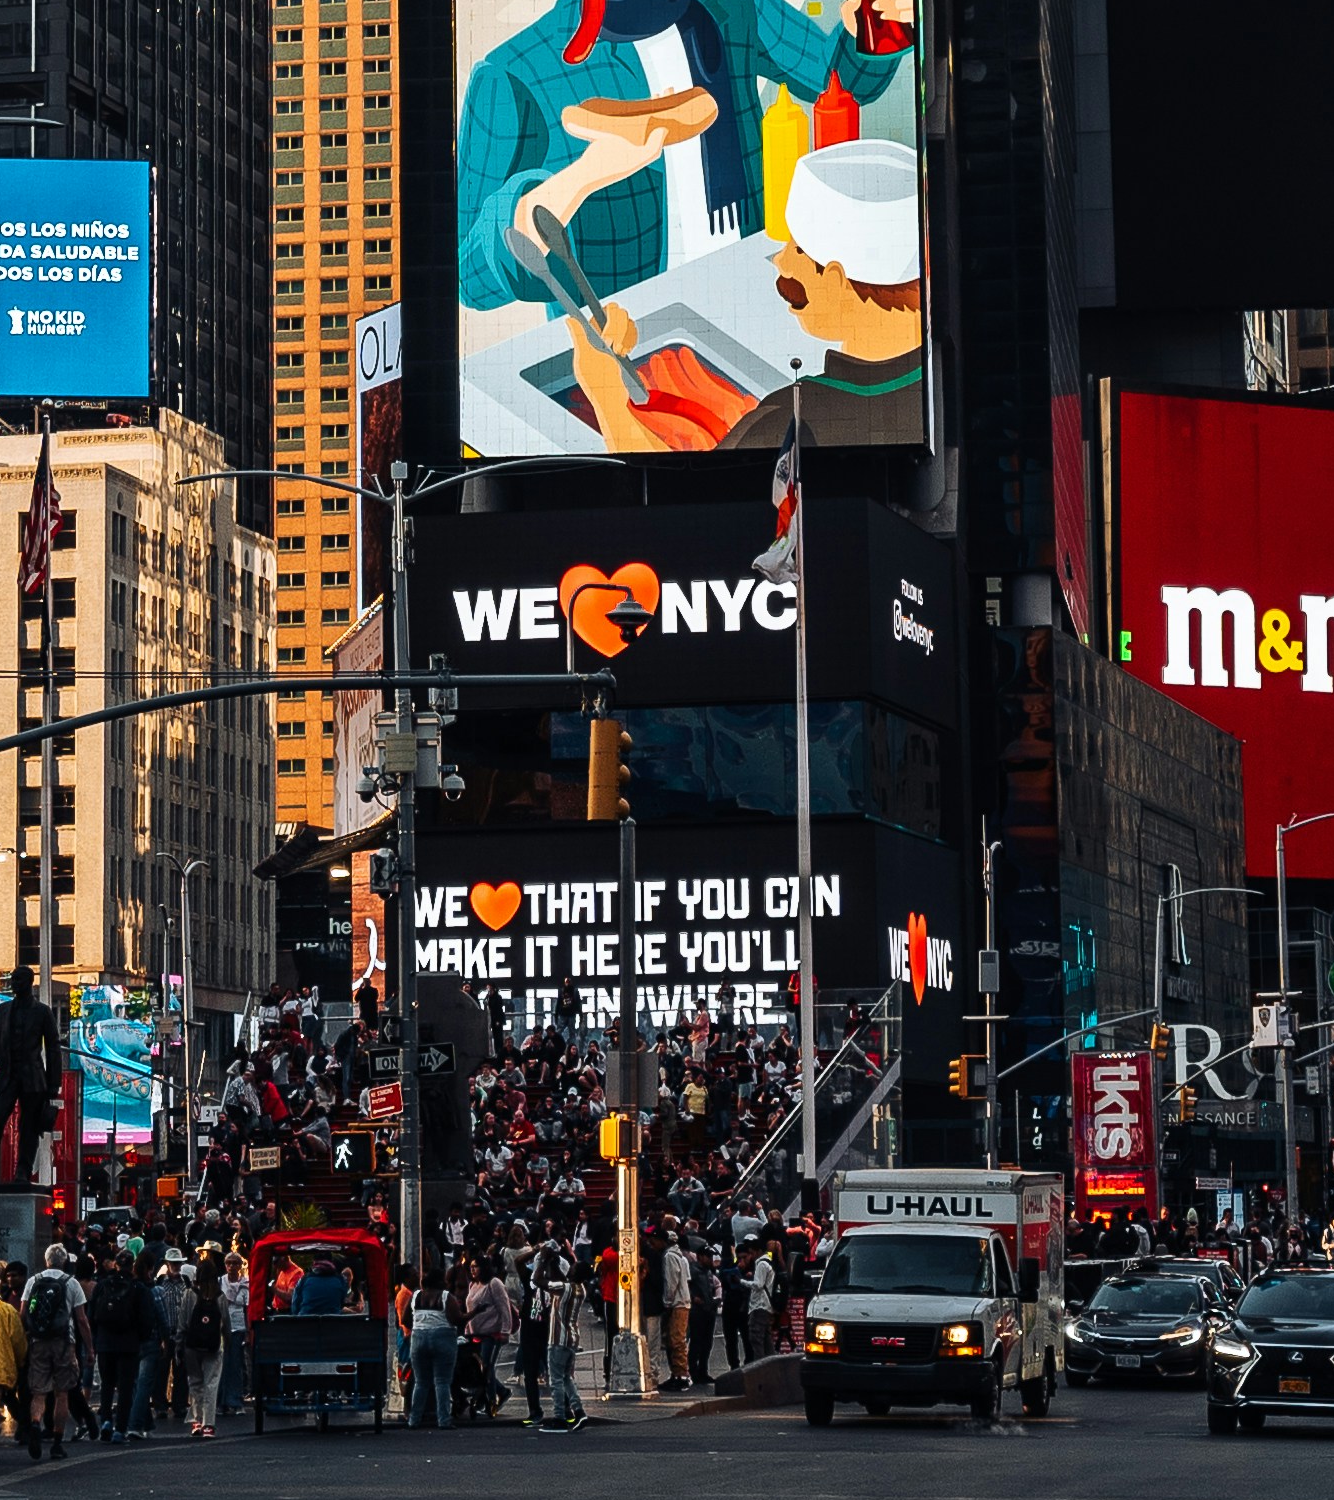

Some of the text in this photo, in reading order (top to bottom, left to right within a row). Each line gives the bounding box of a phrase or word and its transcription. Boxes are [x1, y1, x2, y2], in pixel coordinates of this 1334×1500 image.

[31, 222, 67, 238] LOS
[72, 220, 130, 239] NIÑOS
[30, 244, 140, 261] SALUDABLE
[38, 265, 74, 282] LOS
[78, 264, 122, 283] DÍAS
[28, 311, 85, 324] NO KID
[27, 324, 84, 336] HUNGRY
[453, 577, 798, 641] WE NYC
[413, 885, 469, 929] WE
[522, 882, 619, 926] THAT
[635, 880, 666, 921] IF
[678, 877, 749, 920] YOU
[414, 935, 512, 980] MAKE
[525, 936, 558, 977] IT
[888, 927, 953, 992] WE NYC
[381, 1058, 400, 1070] ON
[1091, 1061, 1141, 1160] tkts
[866, 1194, 993, 1219] U-HAUL
[871, 1336, 906, 1347] GMC
